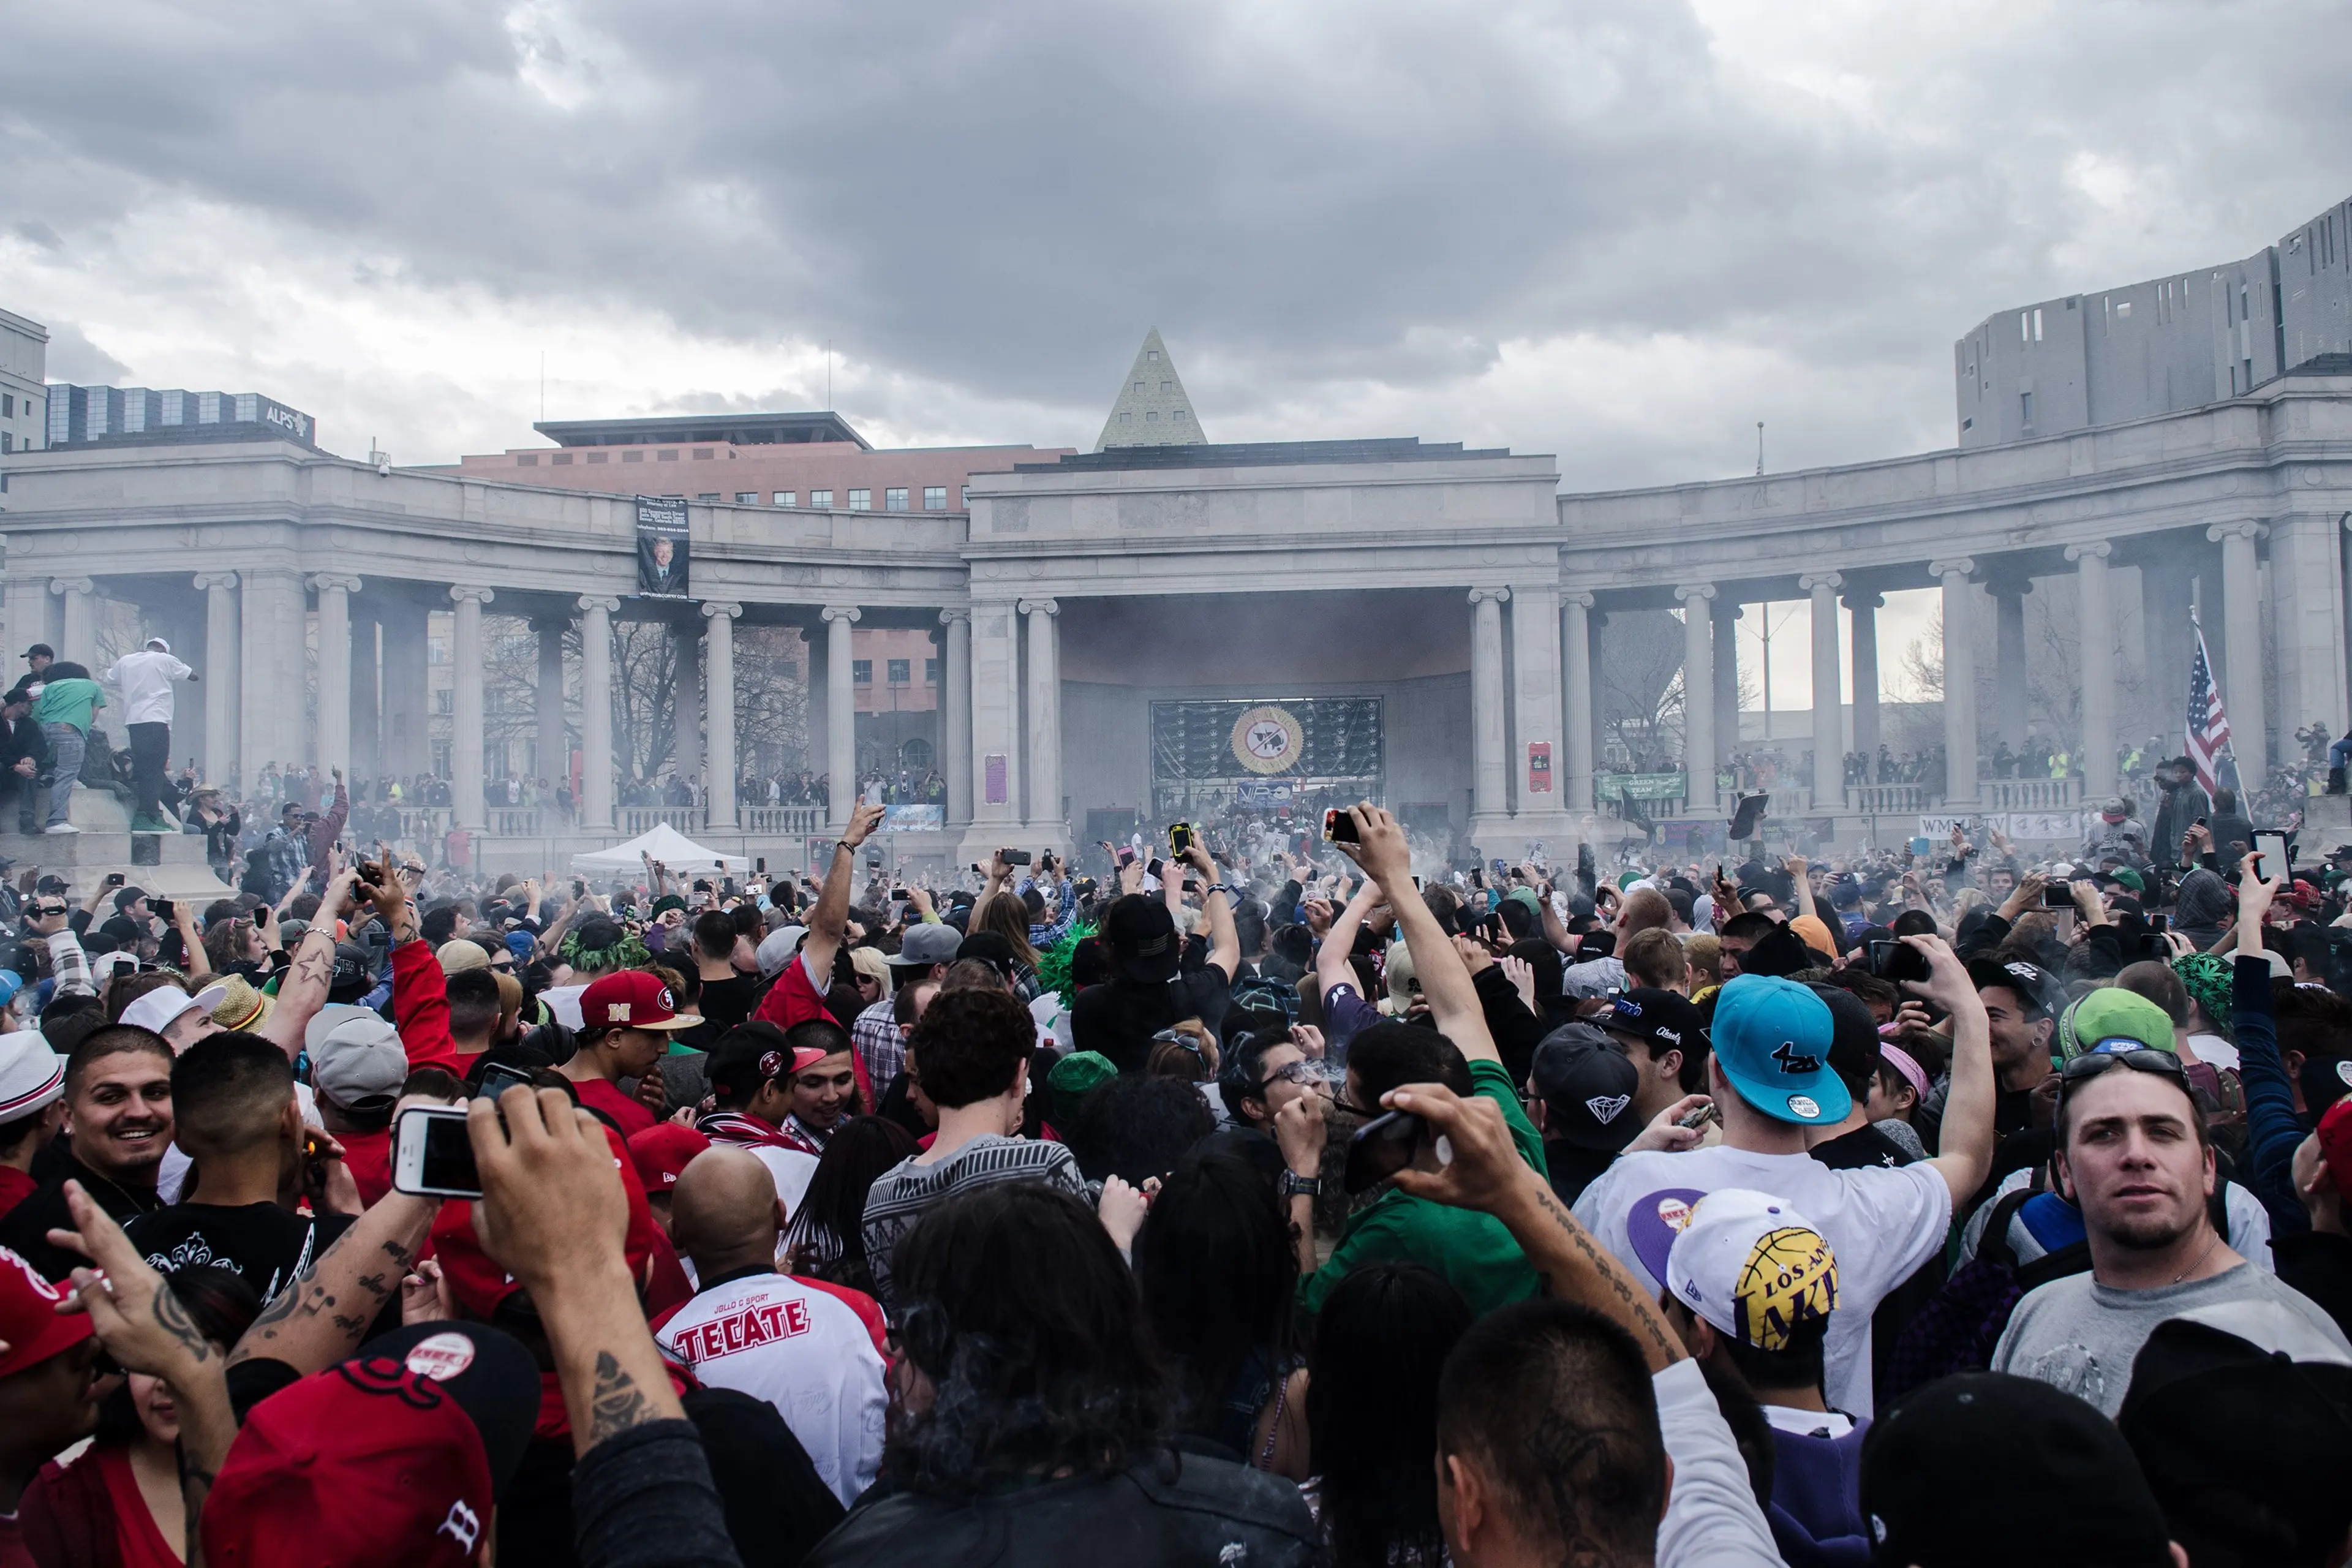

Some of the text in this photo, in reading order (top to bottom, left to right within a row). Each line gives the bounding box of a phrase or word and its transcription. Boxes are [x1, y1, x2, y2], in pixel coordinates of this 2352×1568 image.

[266, 406, 293, 429] ALPS
[1239, 786, 1270, 802] VIP
[608, 1003, 631, 1022] N
[1765, 1263, 1805, 1299] LOS
[746, 1293, 769, 1306] SPORT
[672, 1298, 810, 1366] TECATE
[436, 1499, 480, 1556] B
